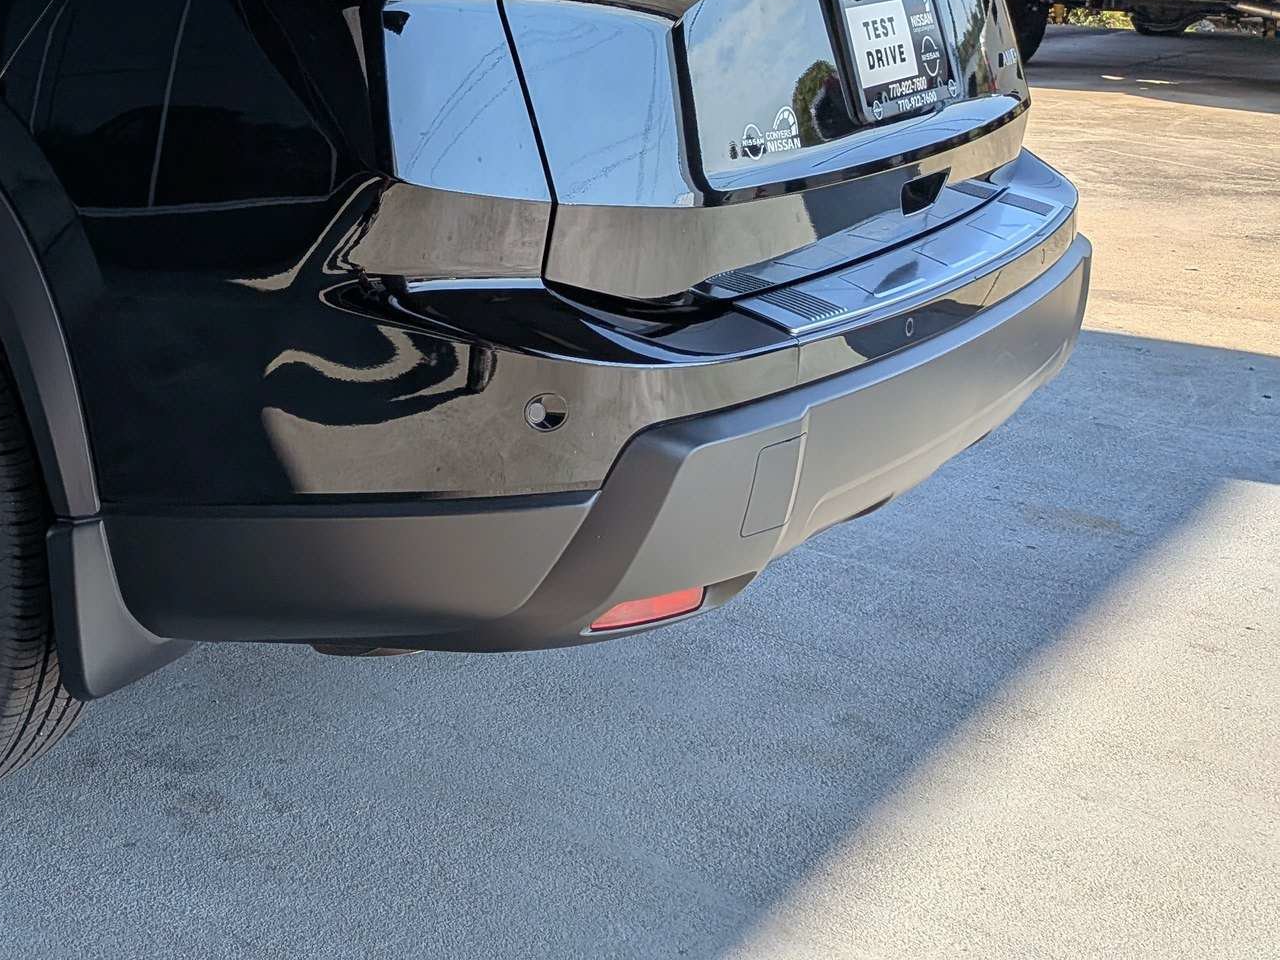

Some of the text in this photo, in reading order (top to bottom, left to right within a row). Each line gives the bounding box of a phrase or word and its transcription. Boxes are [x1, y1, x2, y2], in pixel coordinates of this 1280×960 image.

[862, 16, 896, 41] TEST
[910, 12, 933, 28] NISSAN
[866, 43, 906, 70] DRIVE
[889, 76, 927, 98] 770-922-7600
[898, 90, 937, 112] 770-922-7600
[742, 138, 765, 146] NISSAN
[765, 129, 792, 140] CONYERS
[766, 137, 801, 152] NISSAN
